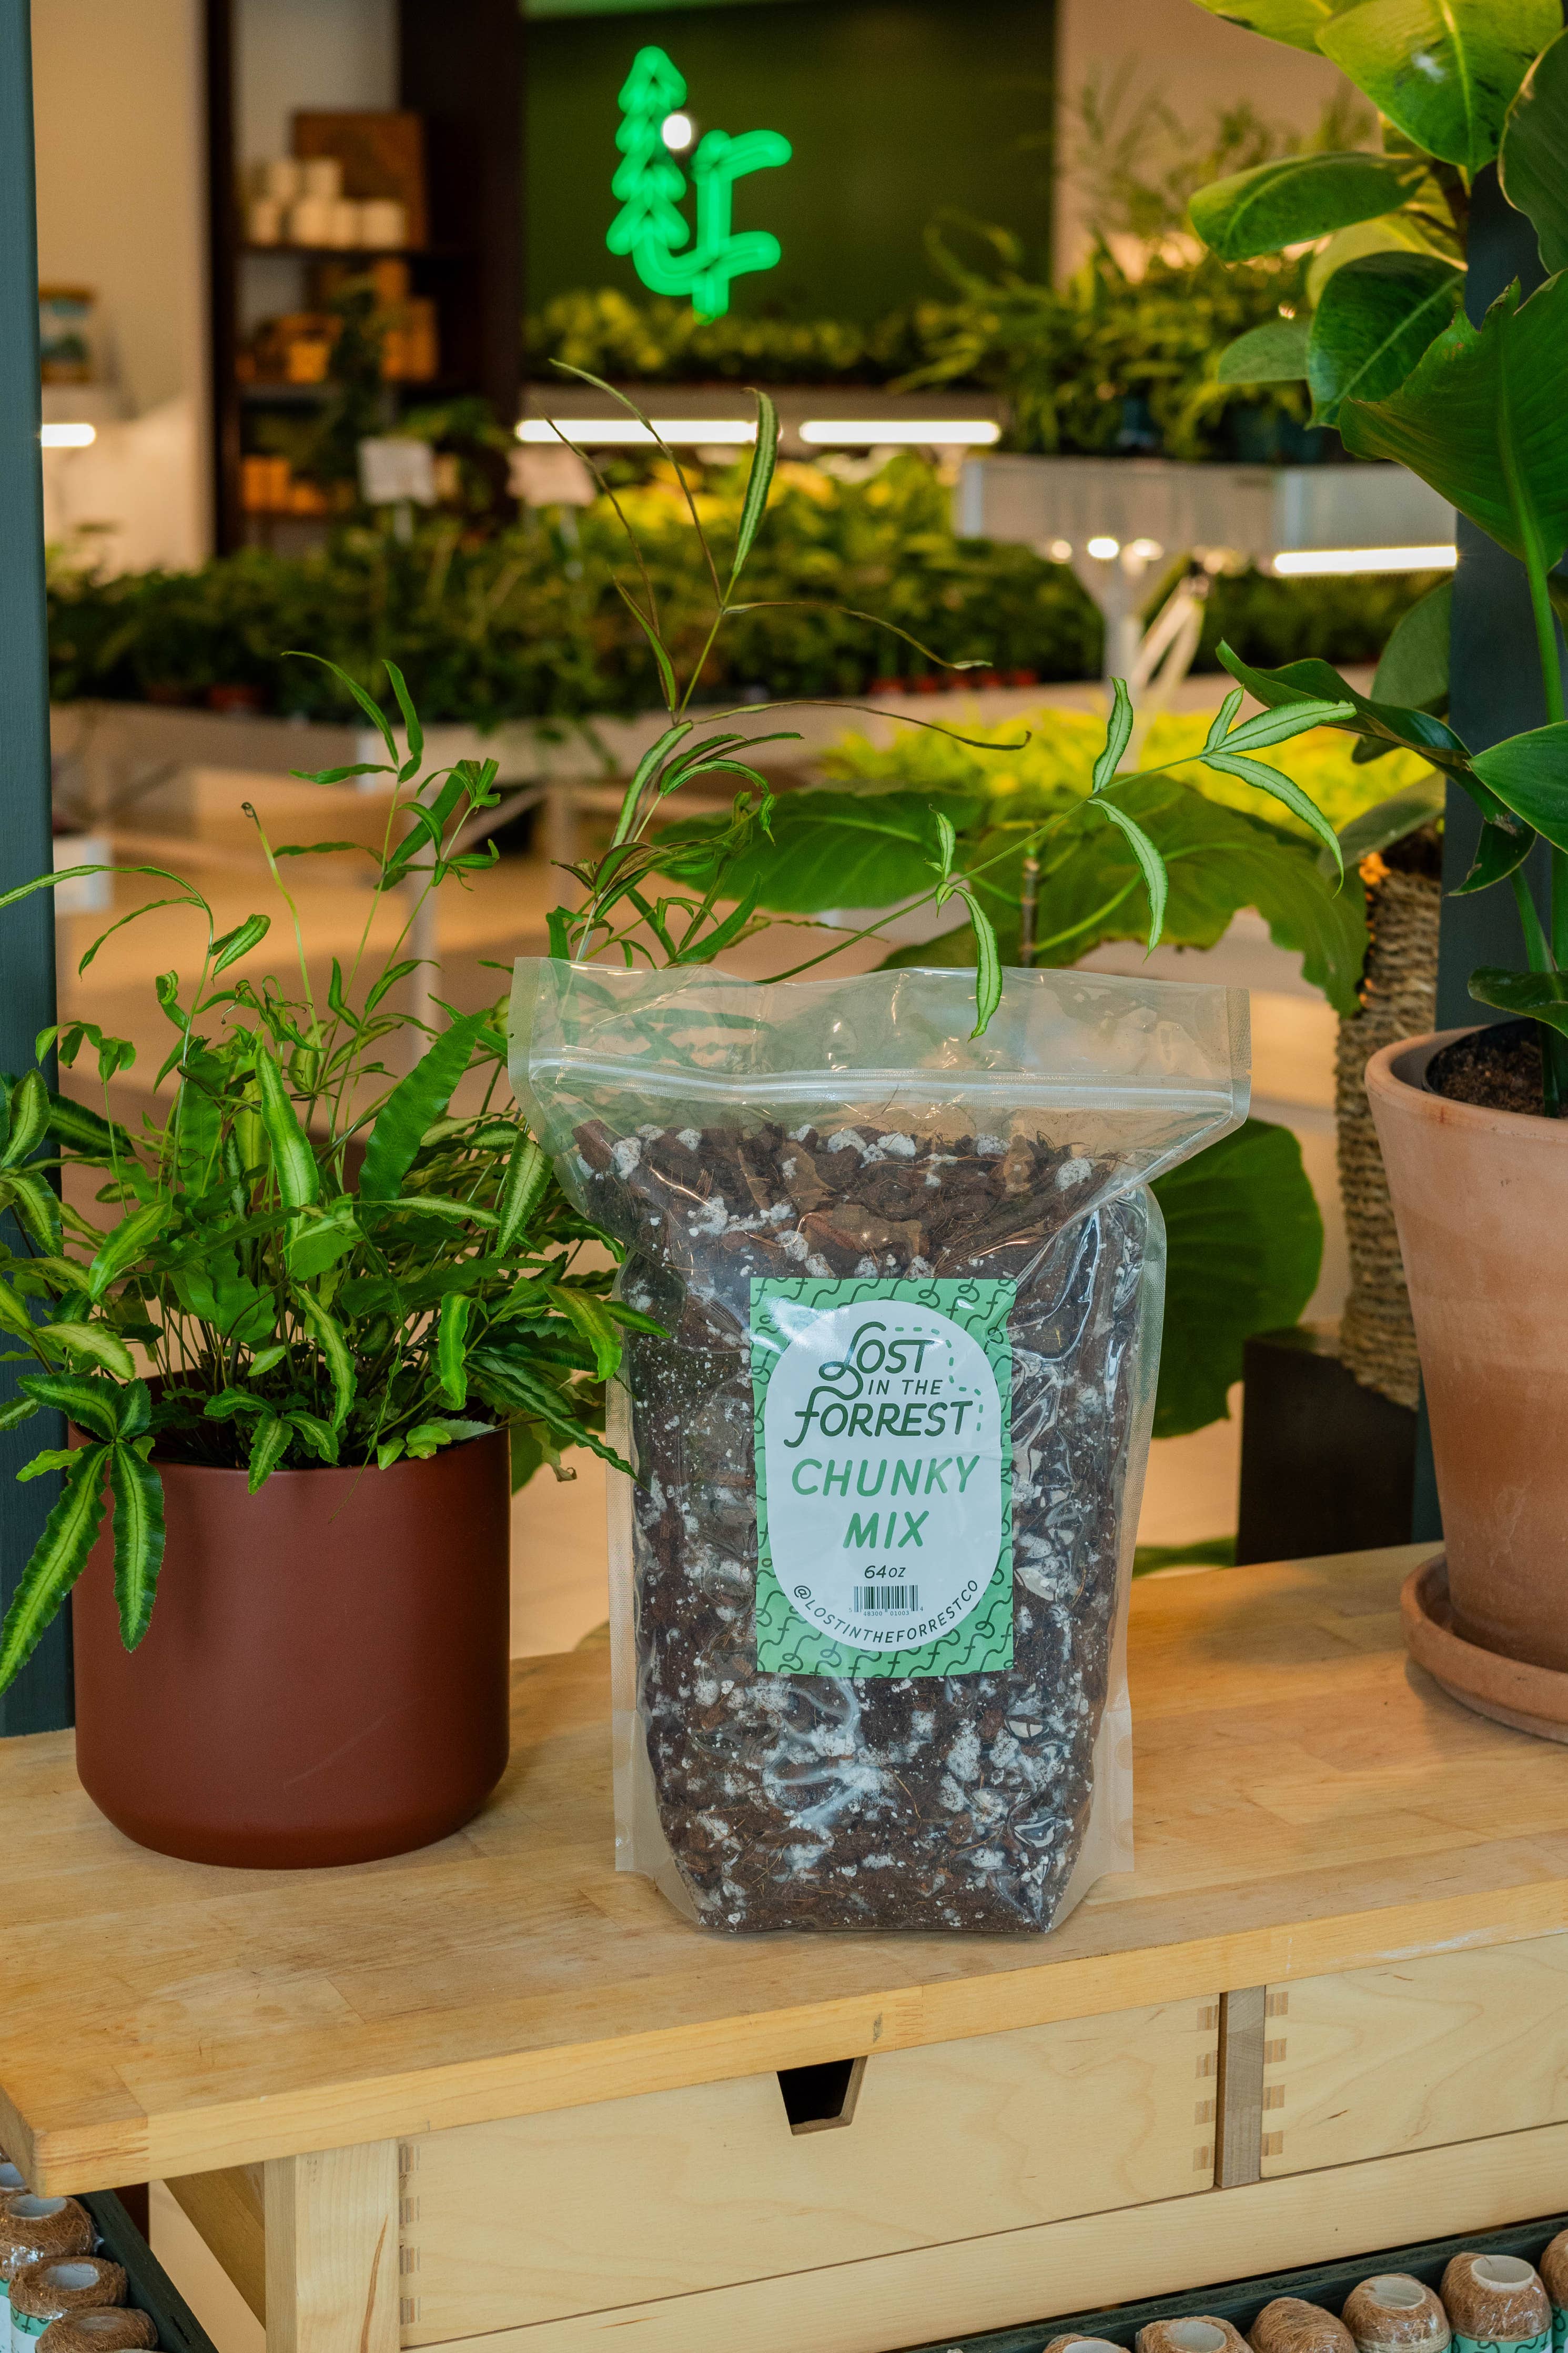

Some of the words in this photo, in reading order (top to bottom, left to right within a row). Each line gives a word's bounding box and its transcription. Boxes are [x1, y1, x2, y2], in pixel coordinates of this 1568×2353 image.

[868, 1380, 889, 1395] IN
[903, 1380, 943, 1395] THE
[791, 1455, 980, 1496] CHUNKY
[844, 1511, 929, 1549] MIX
[793, 1580, 978, 1644] @LOSTINTHEFORRESTCO
